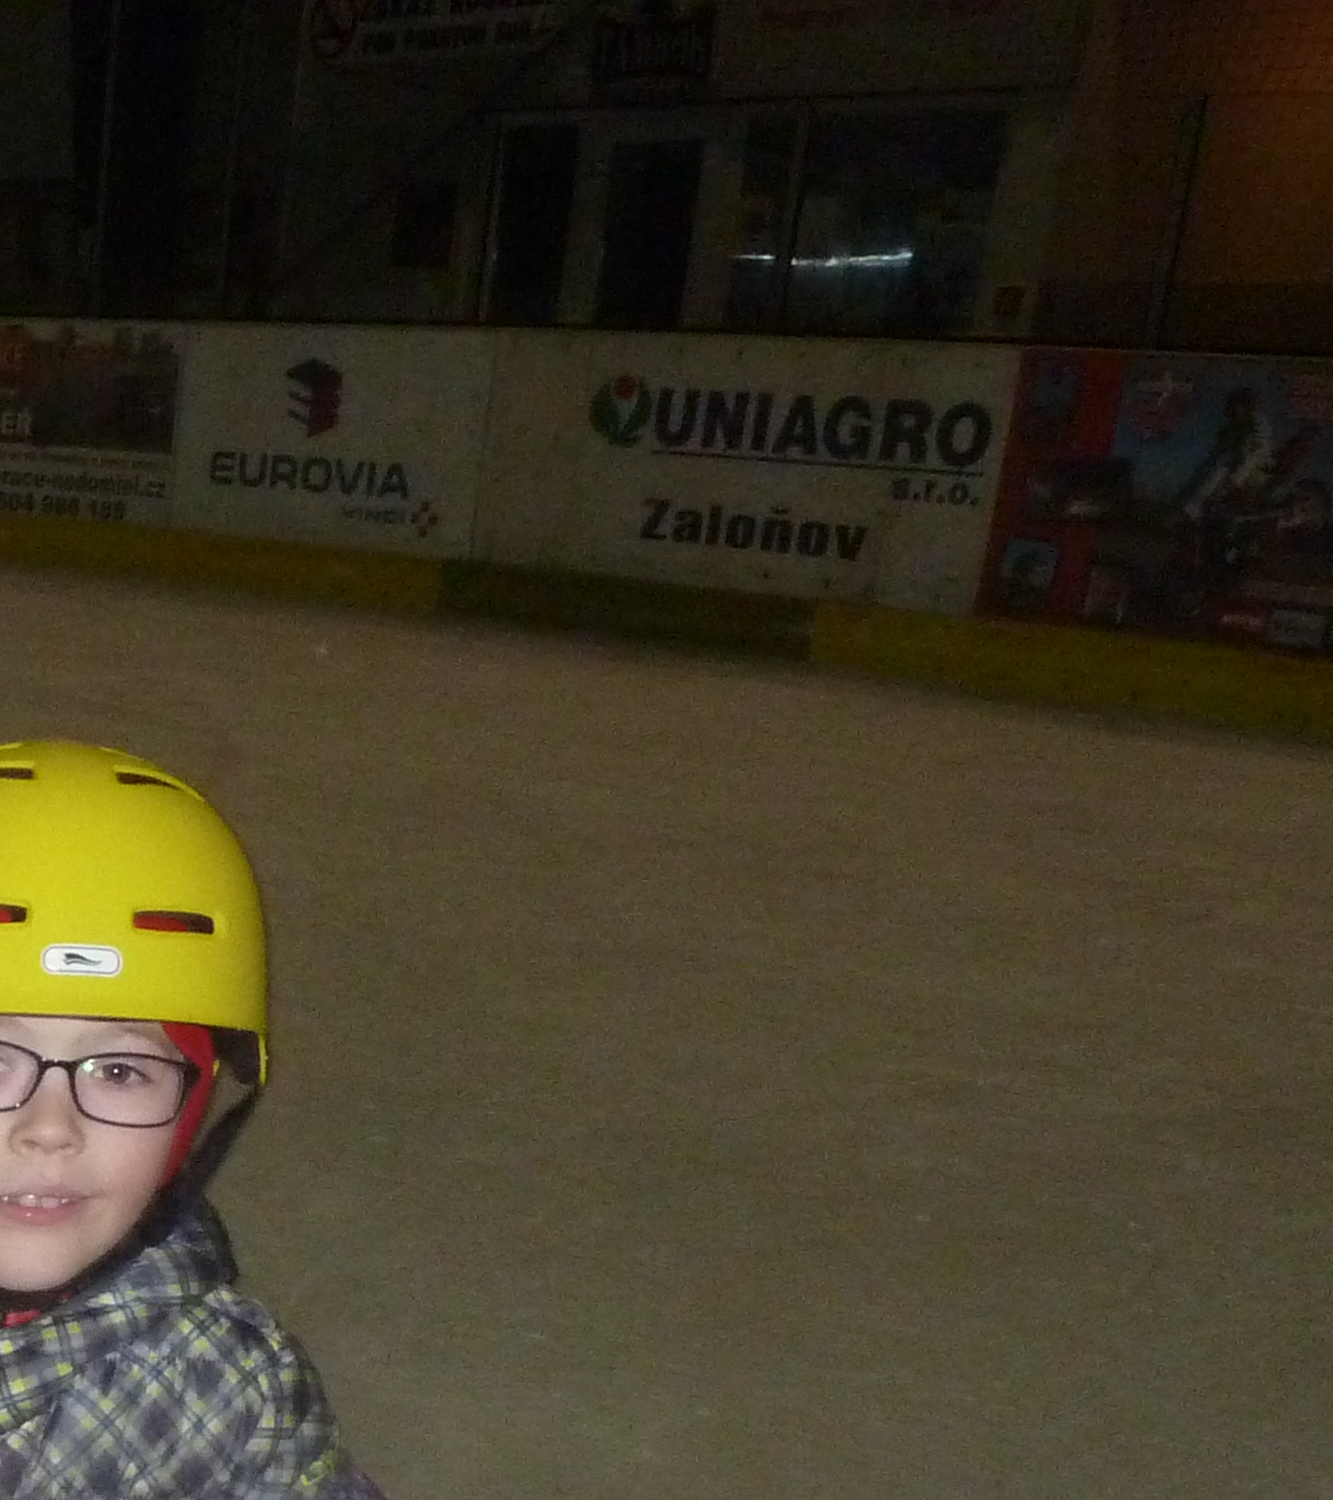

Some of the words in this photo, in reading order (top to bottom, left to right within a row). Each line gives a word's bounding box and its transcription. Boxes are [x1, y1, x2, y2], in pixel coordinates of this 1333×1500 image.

[653, 386, 993, 468] UNIAGRO
[209, 451, 410, 500] EUROVIA
[889, 476, 981, 507] s.r.o.
[639, 497, 869, 562] Zaloňov
